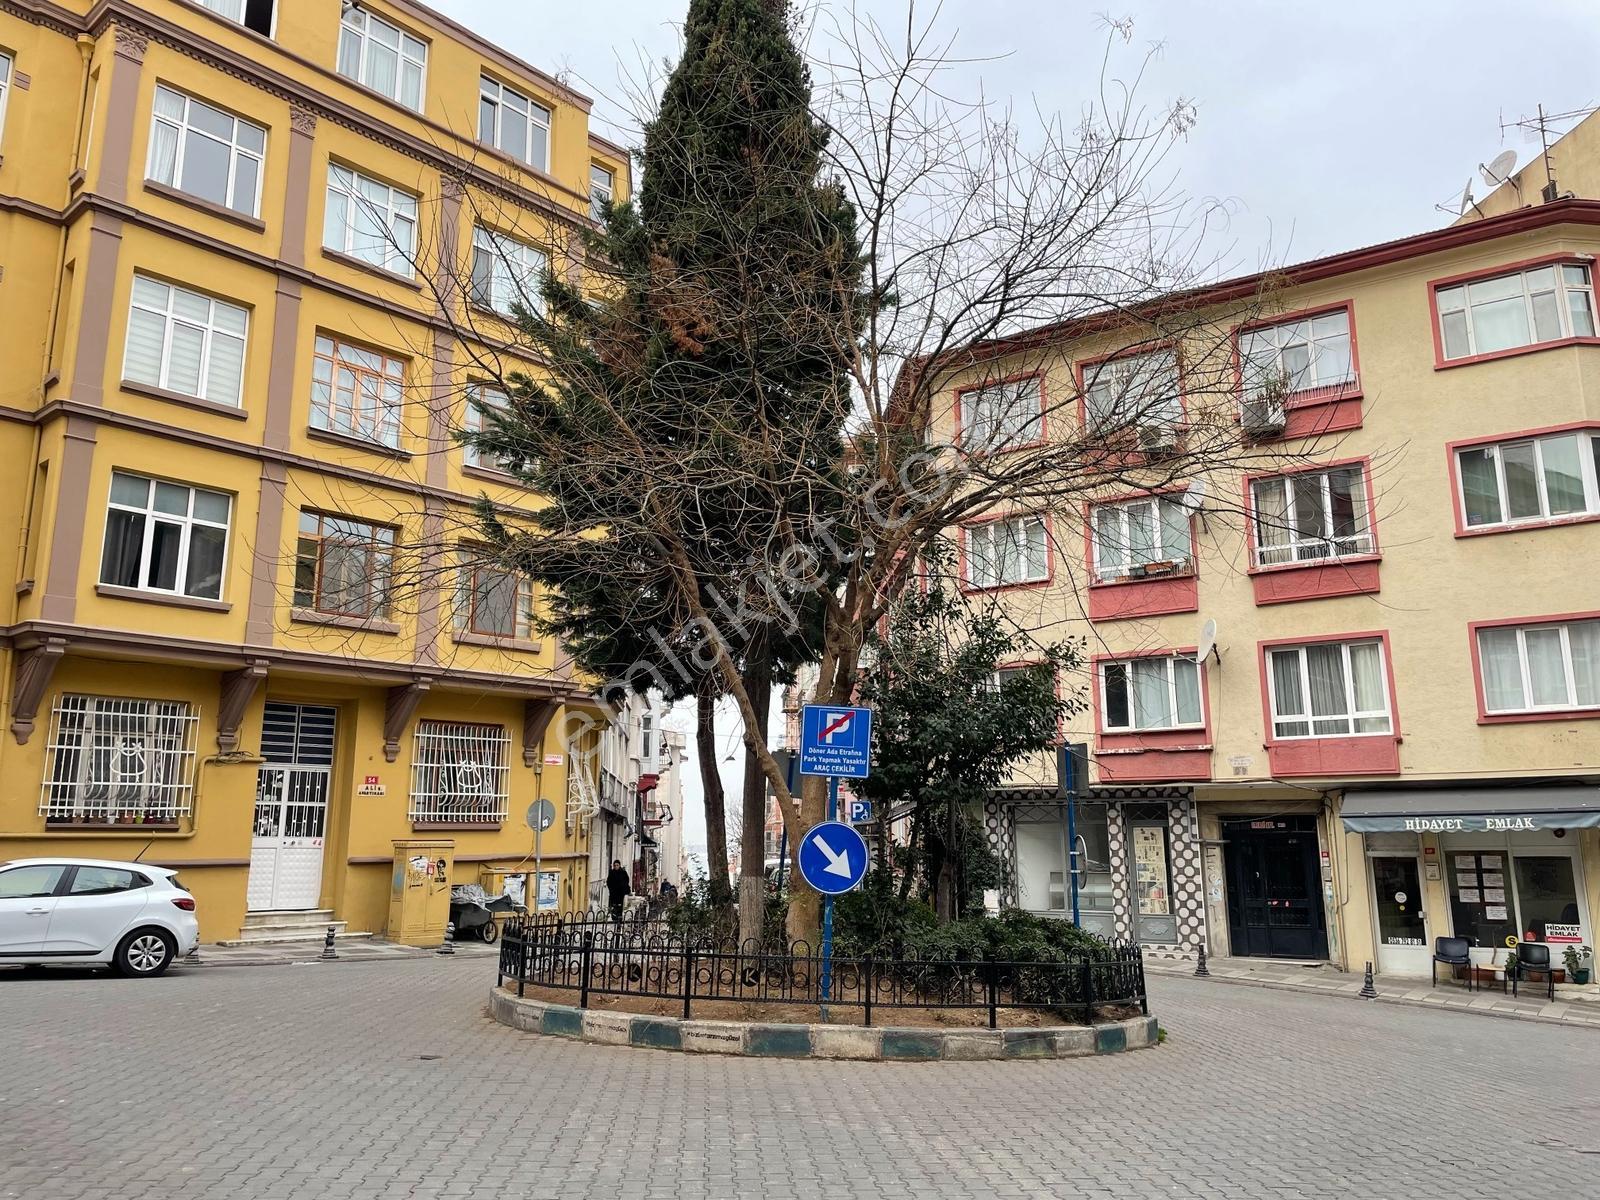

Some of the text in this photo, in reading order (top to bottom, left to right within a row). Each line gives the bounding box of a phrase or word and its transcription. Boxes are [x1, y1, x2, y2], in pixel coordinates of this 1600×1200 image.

[808, 747, 826, 755] Döner
[818, 756, 841, 764] Yapmak
[842, 757, 866, 765] Yasaktır
[813, 764, 855, 773] ARAÇ ÇEKİLİR
[852, 803, 864, 818] P
[1405, 817, 1535, 831] HİDAYET EMLAK
[1546, 924, 1581, 932] HİDAYET
